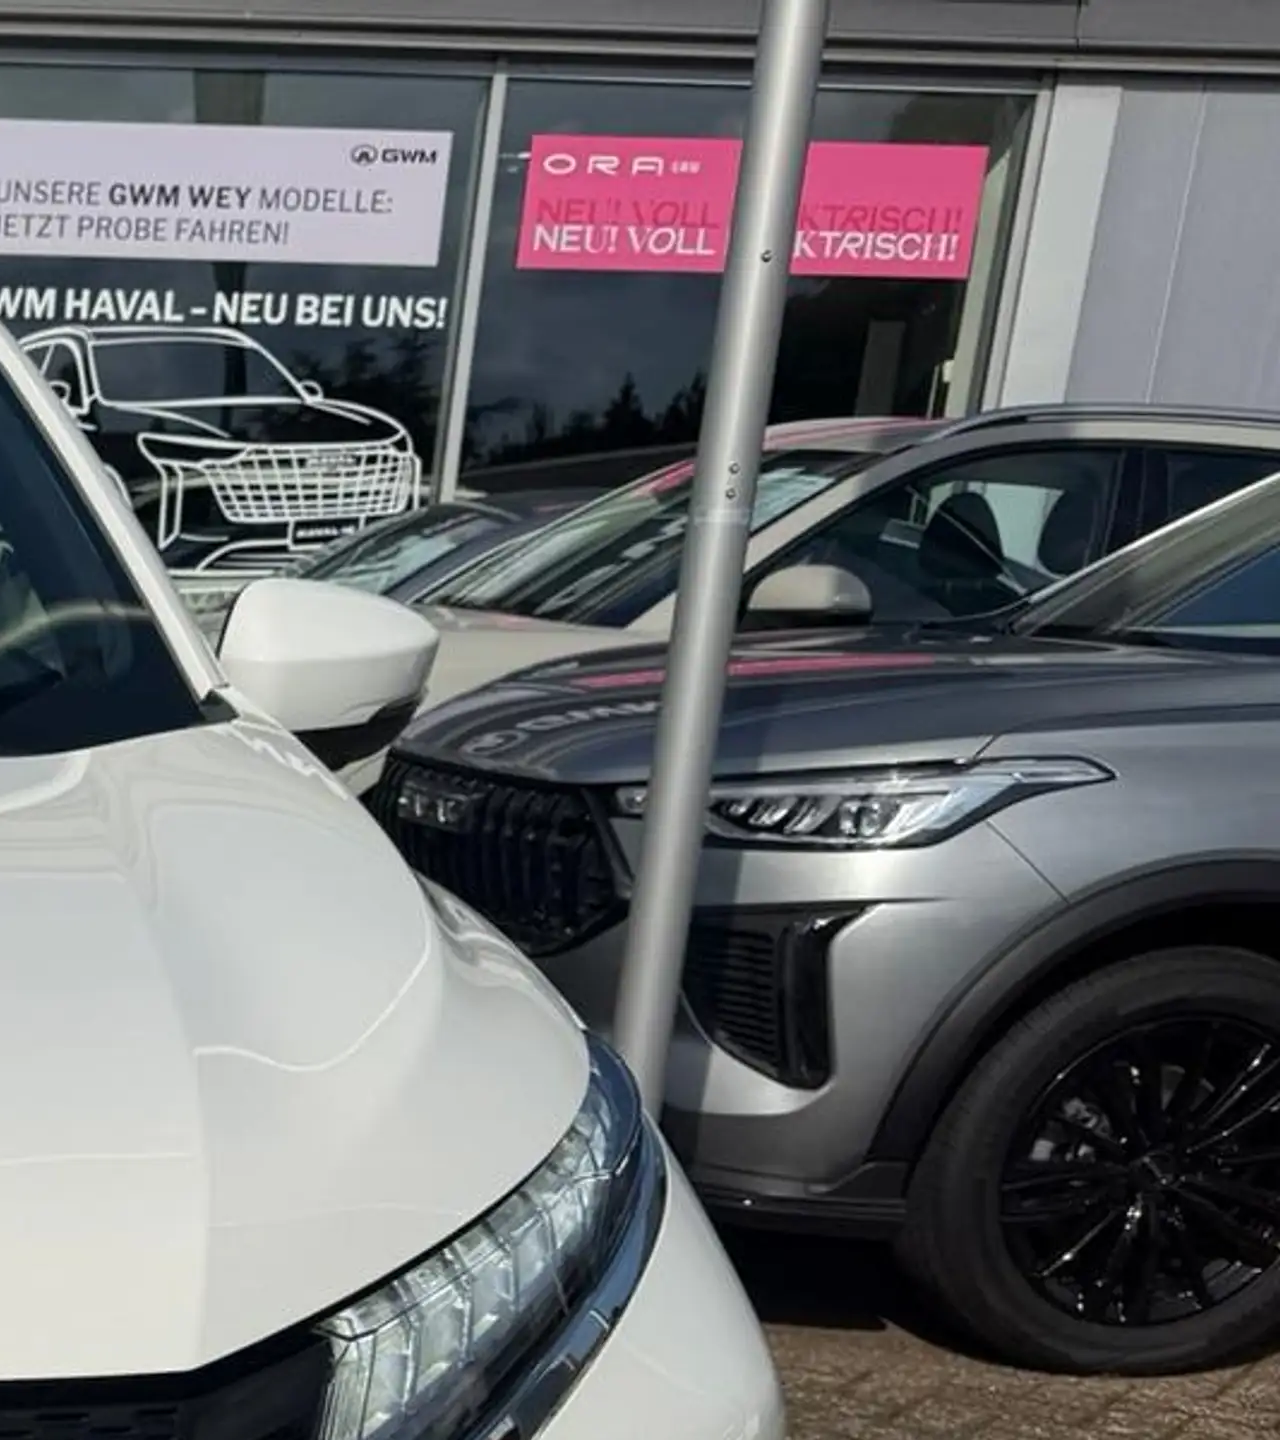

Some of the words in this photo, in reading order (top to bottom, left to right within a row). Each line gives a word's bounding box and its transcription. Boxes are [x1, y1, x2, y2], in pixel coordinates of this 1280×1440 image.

[381, 148, 438, 165] GWM
[543, 153, 665, 176] ORA
[108, 183, 180, 208] GWM
[189, 185, 251, 210] WEY
[259, 188, 393, 214] MODELLE:
[77, 215, 168, 242] PROBE
[174, 218, 290, 246] FAHREN!
[533, 224, 619, 254] NEU!
[627, 225, 717, 256] VOLL
[63, 287, 185, 323] HAVAL
[212, 290, 289, 326] NEU
[294, 293, 355, 328] BEI
[361, 295, 448, 330] UNS!
